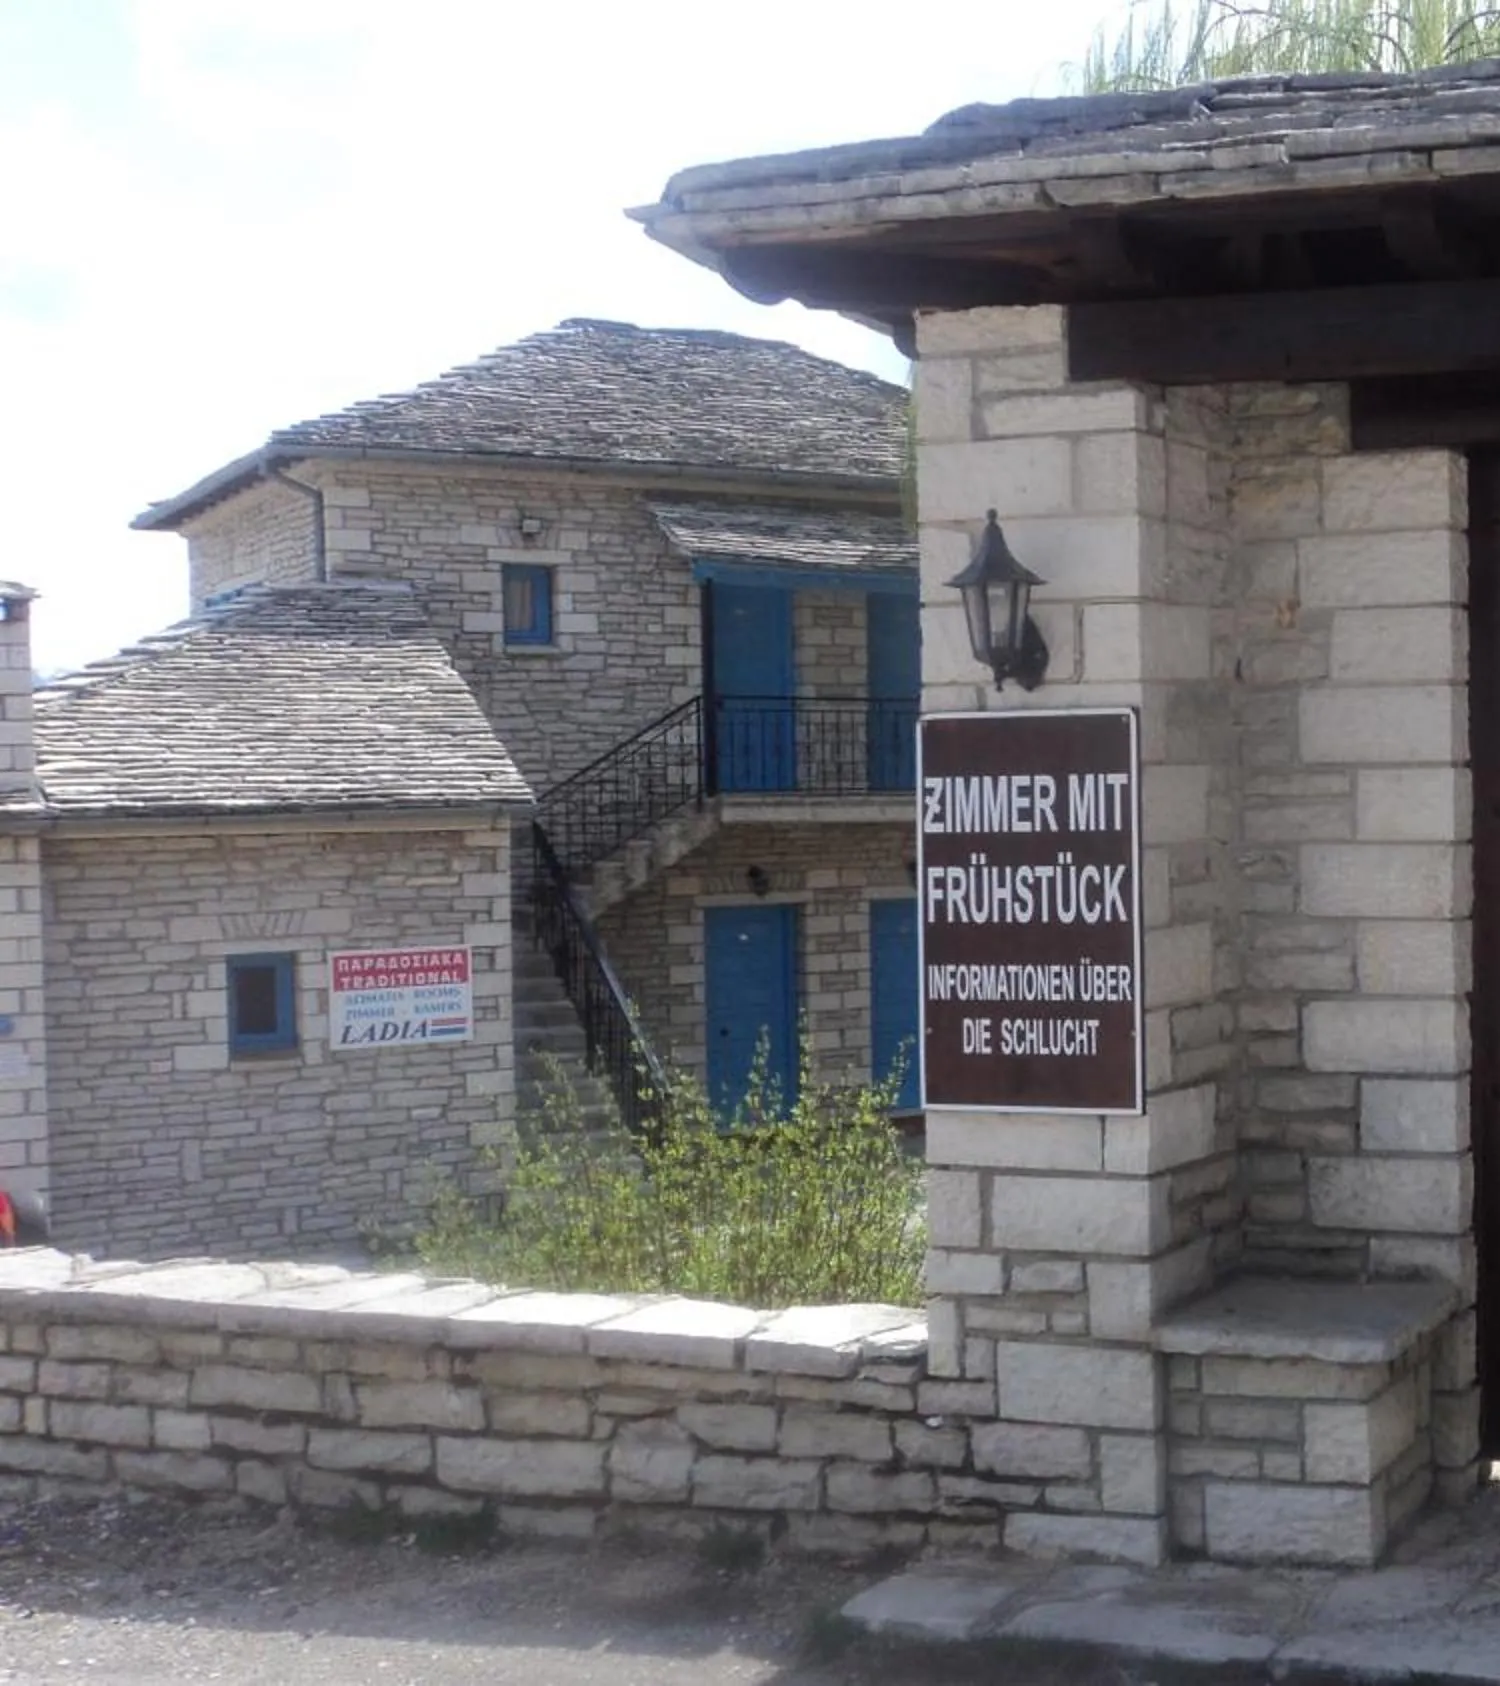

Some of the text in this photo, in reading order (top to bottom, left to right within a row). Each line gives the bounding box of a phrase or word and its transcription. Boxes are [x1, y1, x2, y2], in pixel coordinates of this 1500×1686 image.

[924, 773, 1129, 833] ZIMMER MIT
[927, 851, 1128, 924] FRÜHSTÜCK
[338, 952, 465, 972] ΠΑΡΑΔΟΣΙΑΚΑ
[340, 970, 462, 989] TRADITIONAL
[928, 958, 1132, 1001] INFORMATIONEN ÜBER
[340, 1018, 428, 1044] LADIA
[963, 1018, 1099, 1056] DIE SCHLUCHT
